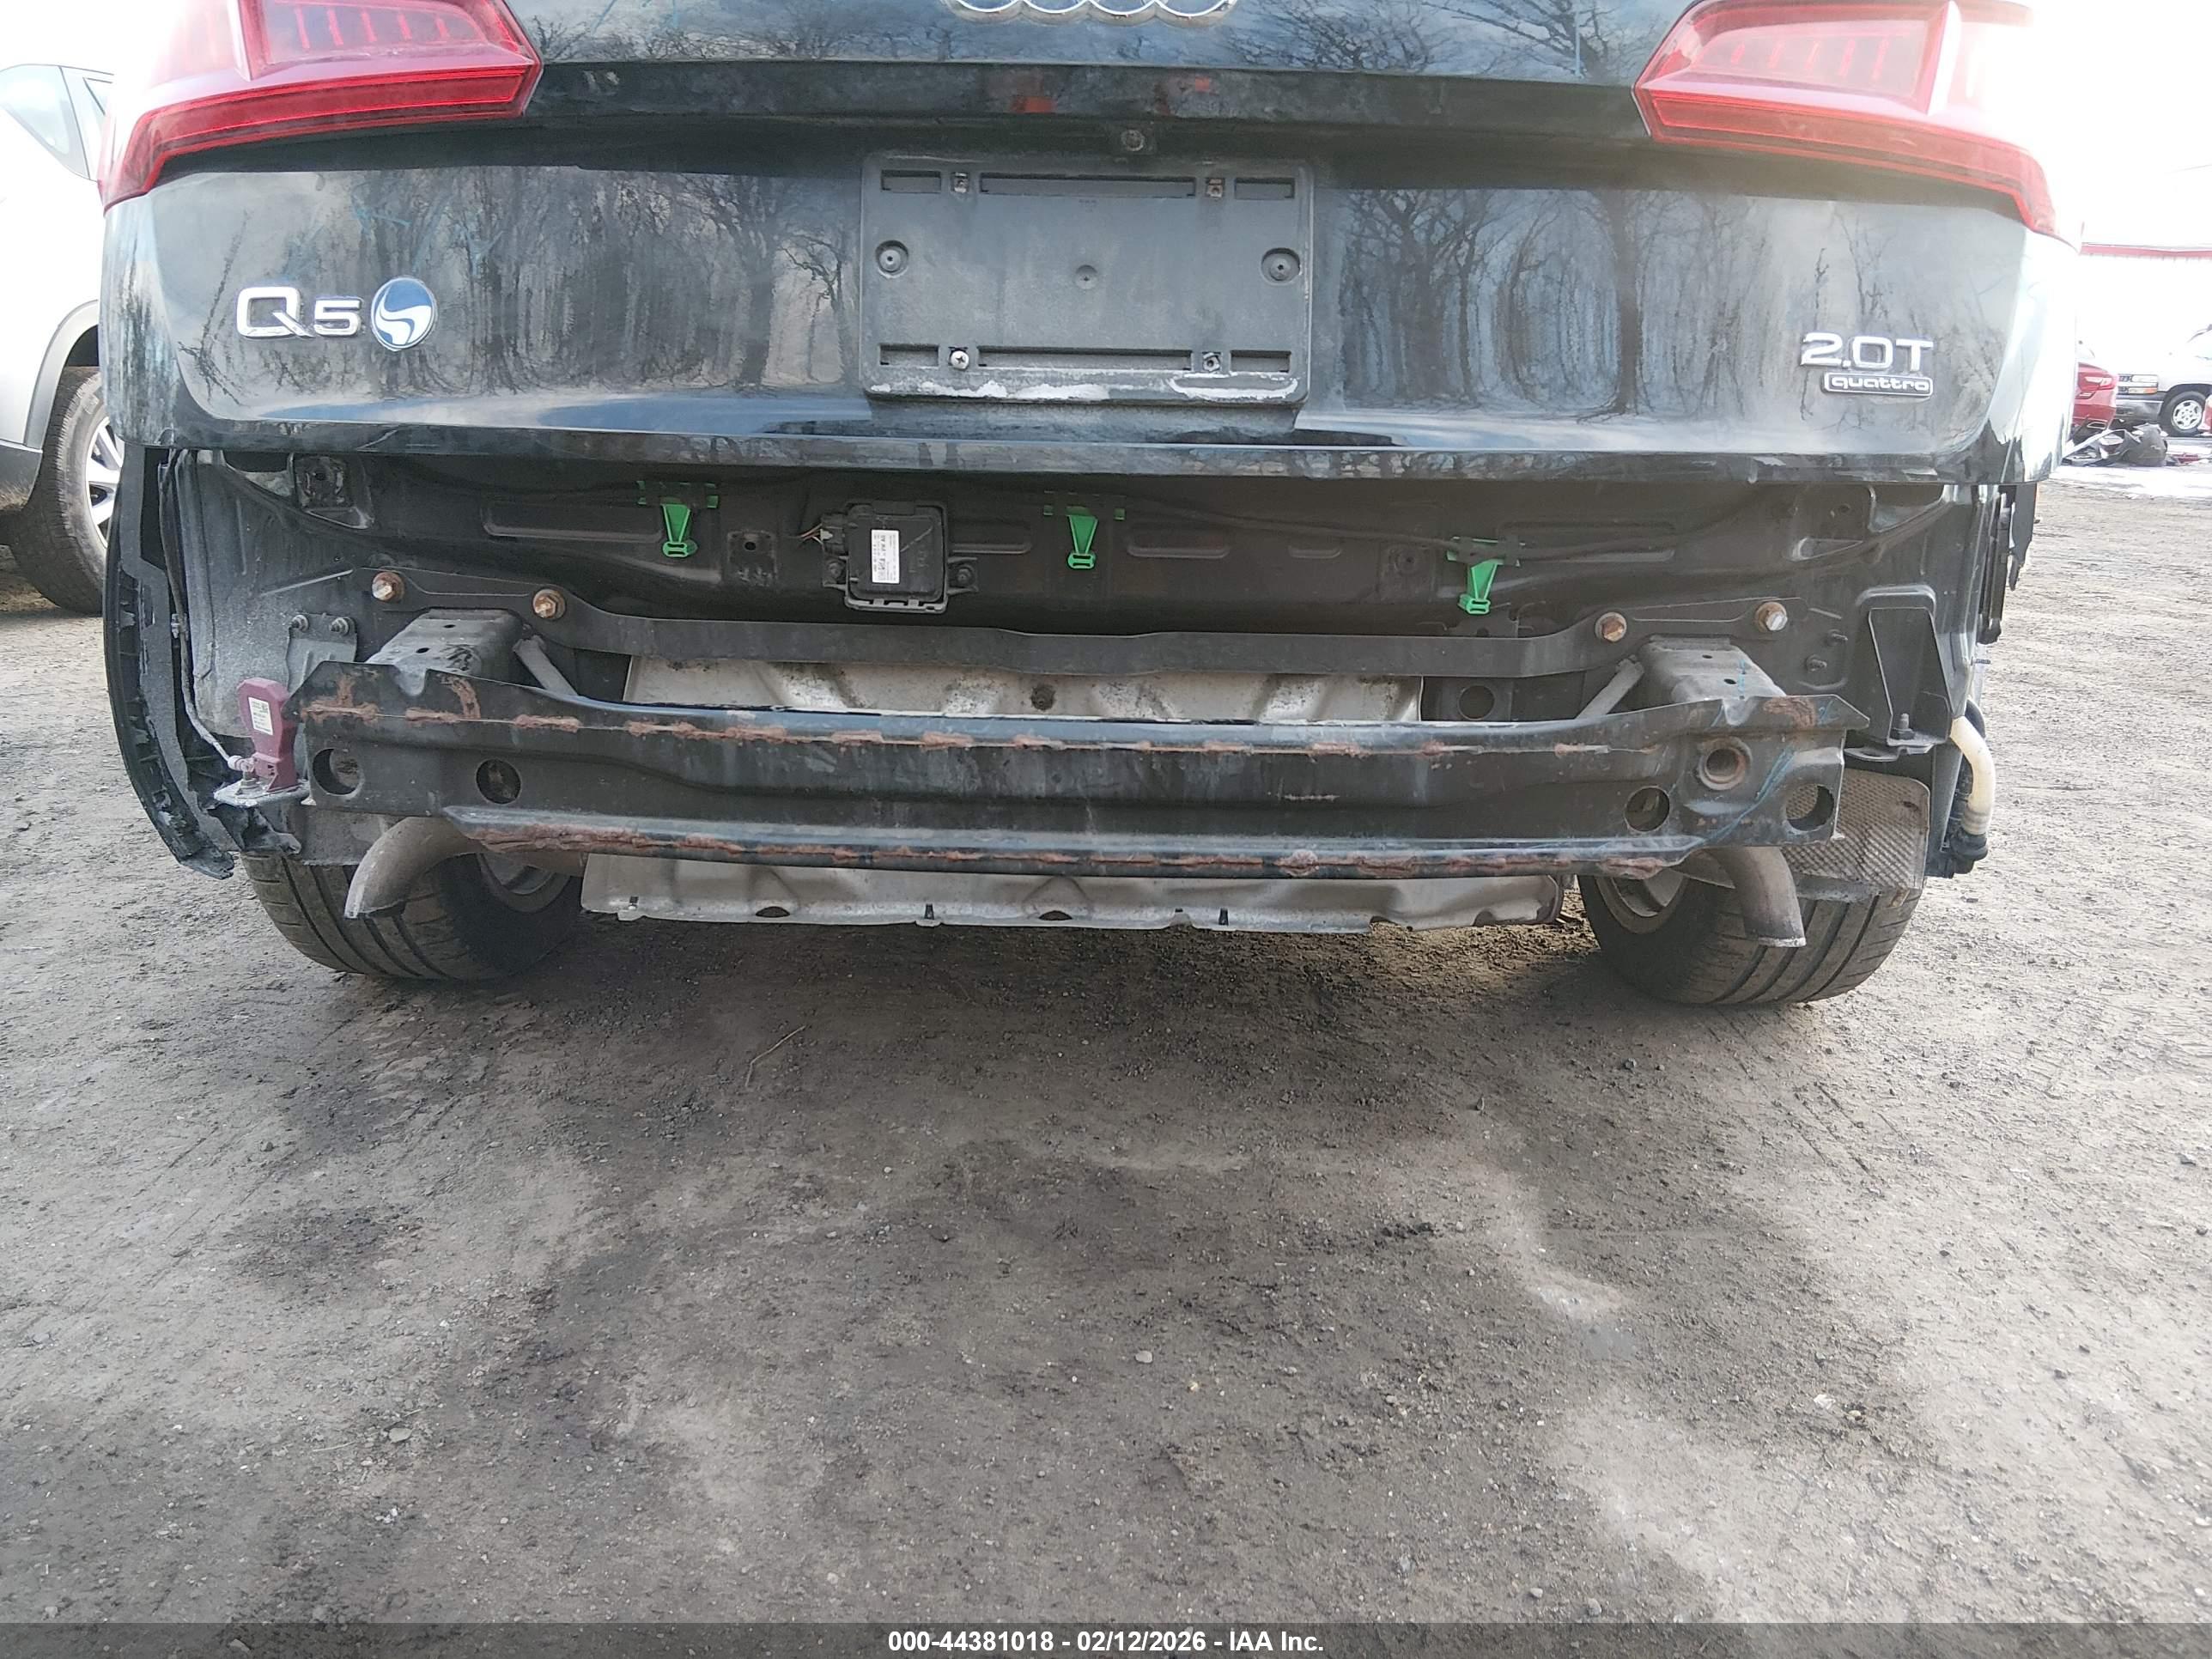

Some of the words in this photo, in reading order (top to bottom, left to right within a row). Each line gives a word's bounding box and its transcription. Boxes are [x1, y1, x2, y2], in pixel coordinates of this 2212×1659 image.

[236, 286, 362, 338] Q5
[1800, 331, 1934, 372] 2.0T
[1831, 376, 1930, 392] quattro
